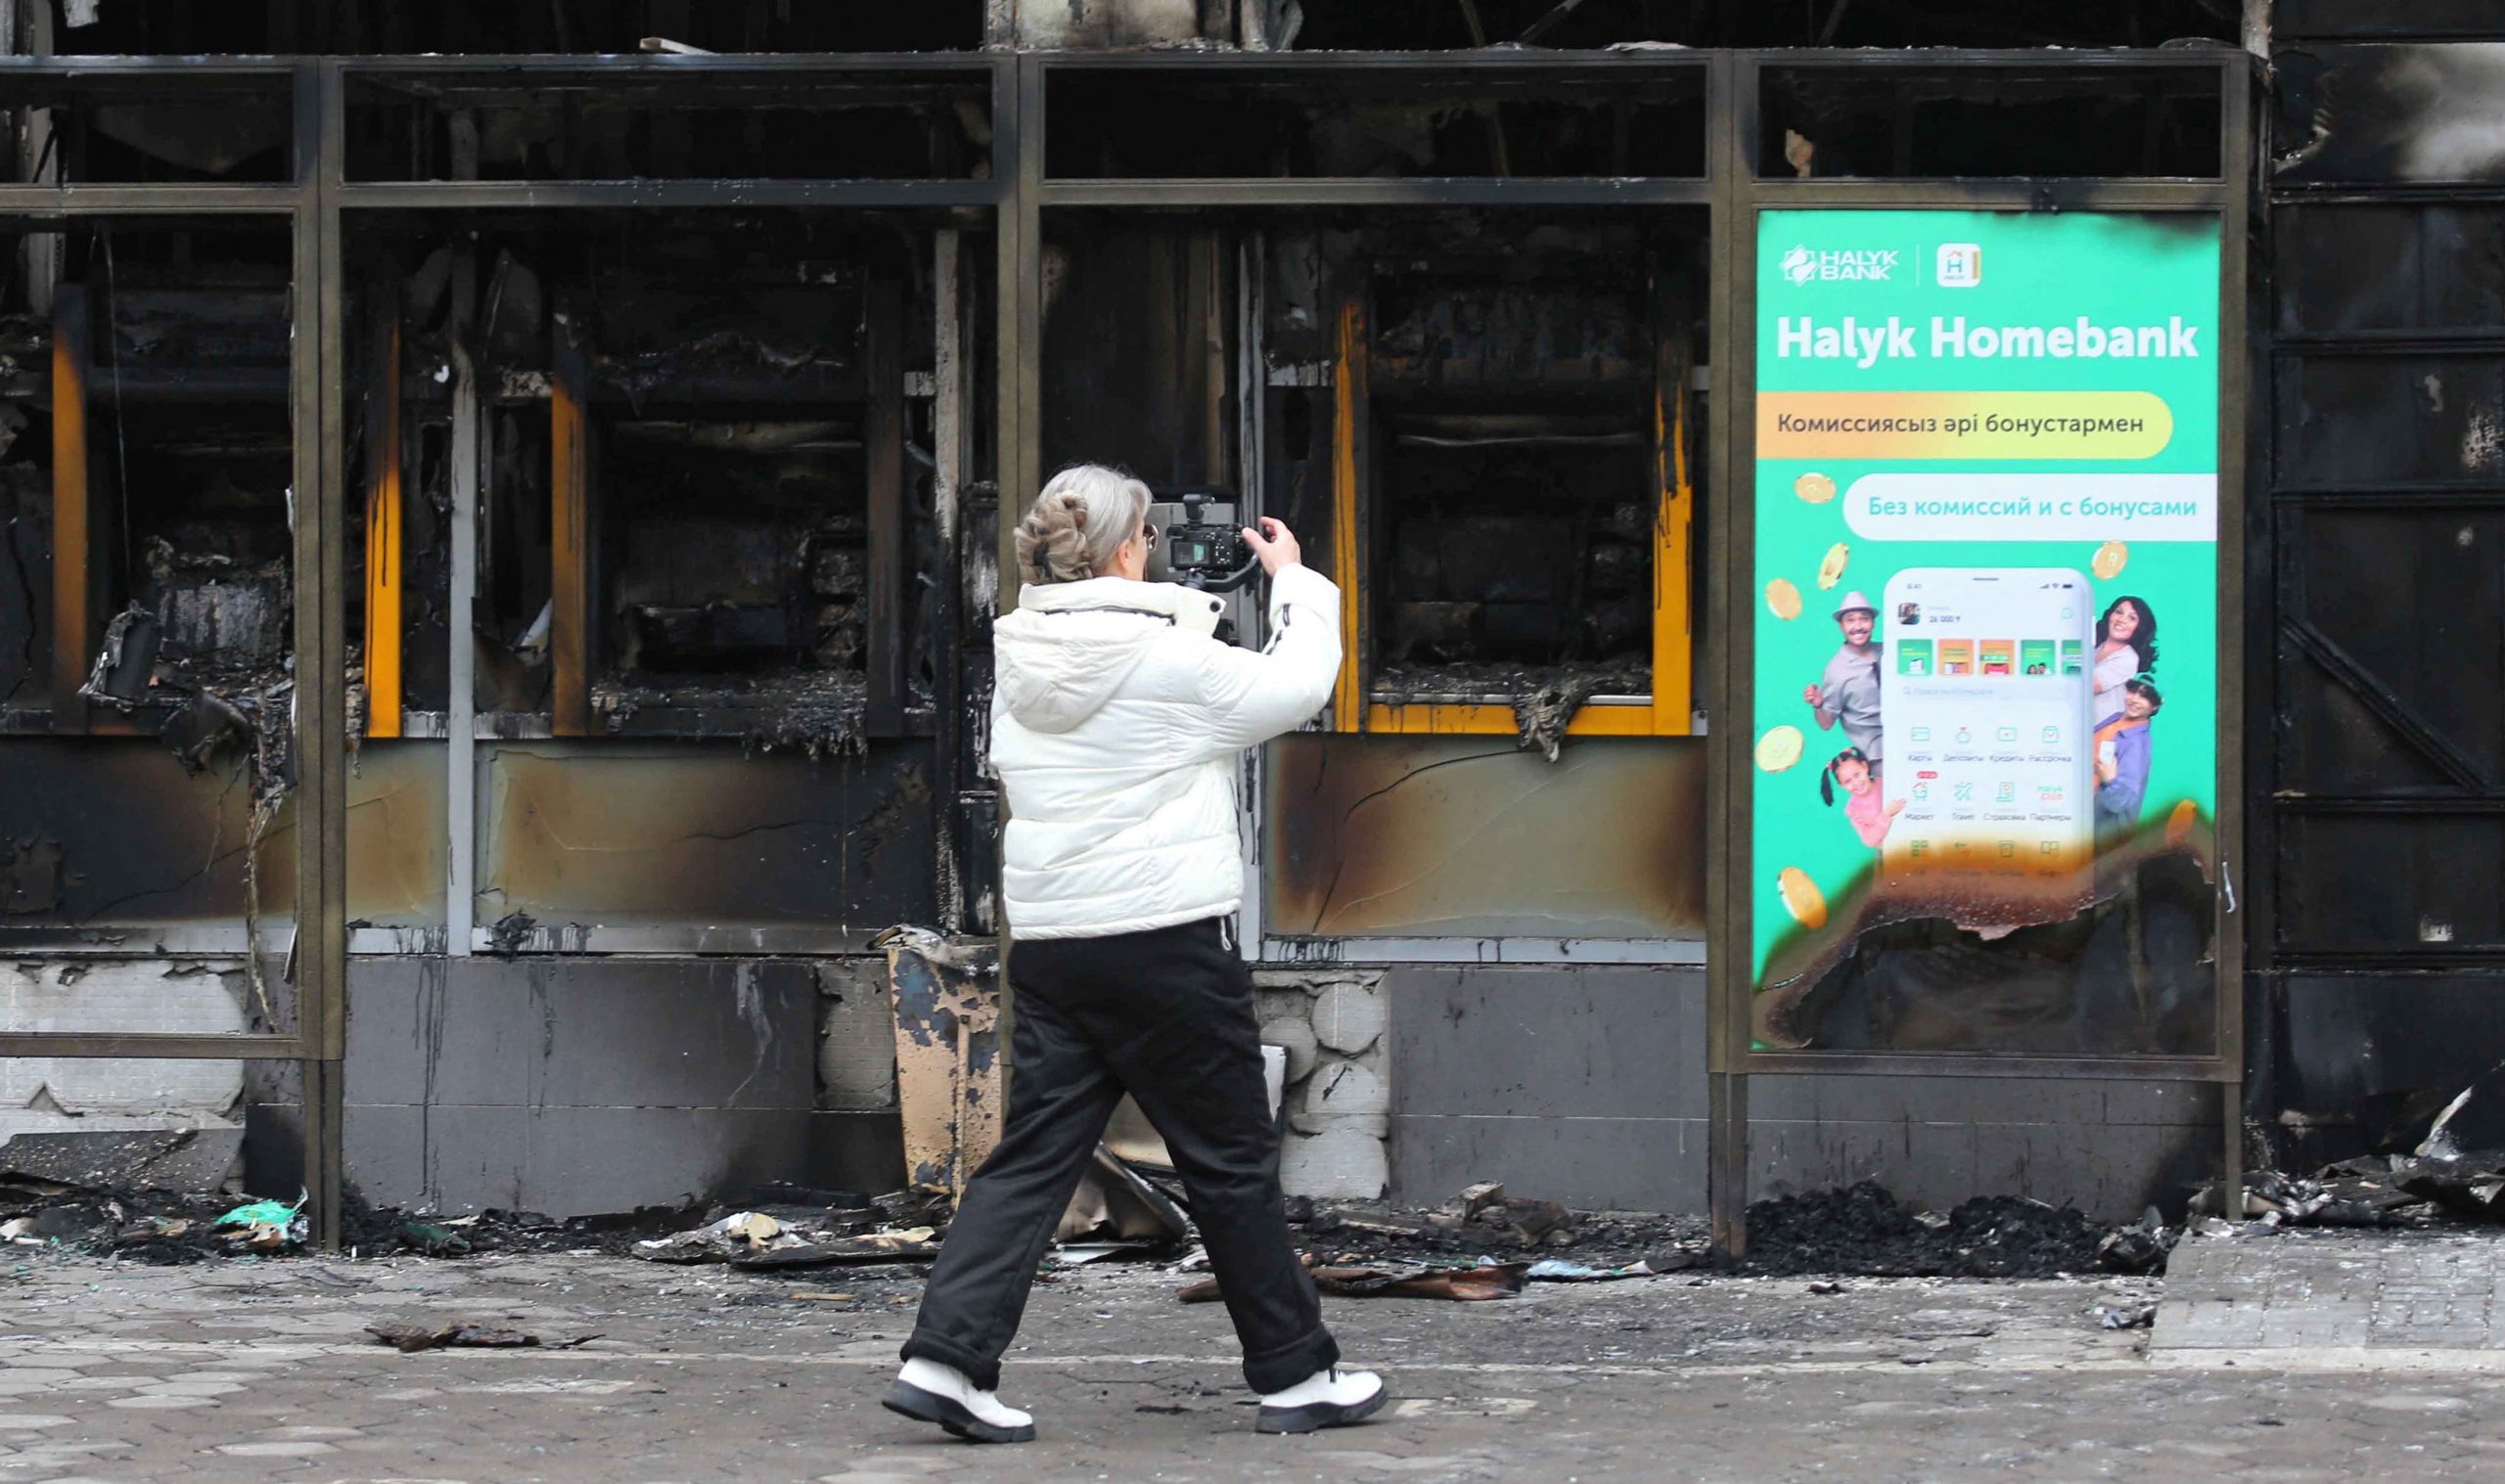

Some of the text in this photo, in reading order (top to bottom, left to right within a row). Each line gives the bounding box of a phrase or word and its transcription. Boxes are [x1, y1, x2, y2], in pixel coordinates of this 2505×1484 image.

[1820, 250, 1899, 265] HALYK
[1820, 264, 1891, 281] BANK
[1777, 315, 2200, 369] Halyk Homebank
[1777, 414, 2144, 438] Комиссиясыз әрі бонустармен
[1869, 496, 2197, 523] Без комиссий и с бонусами
